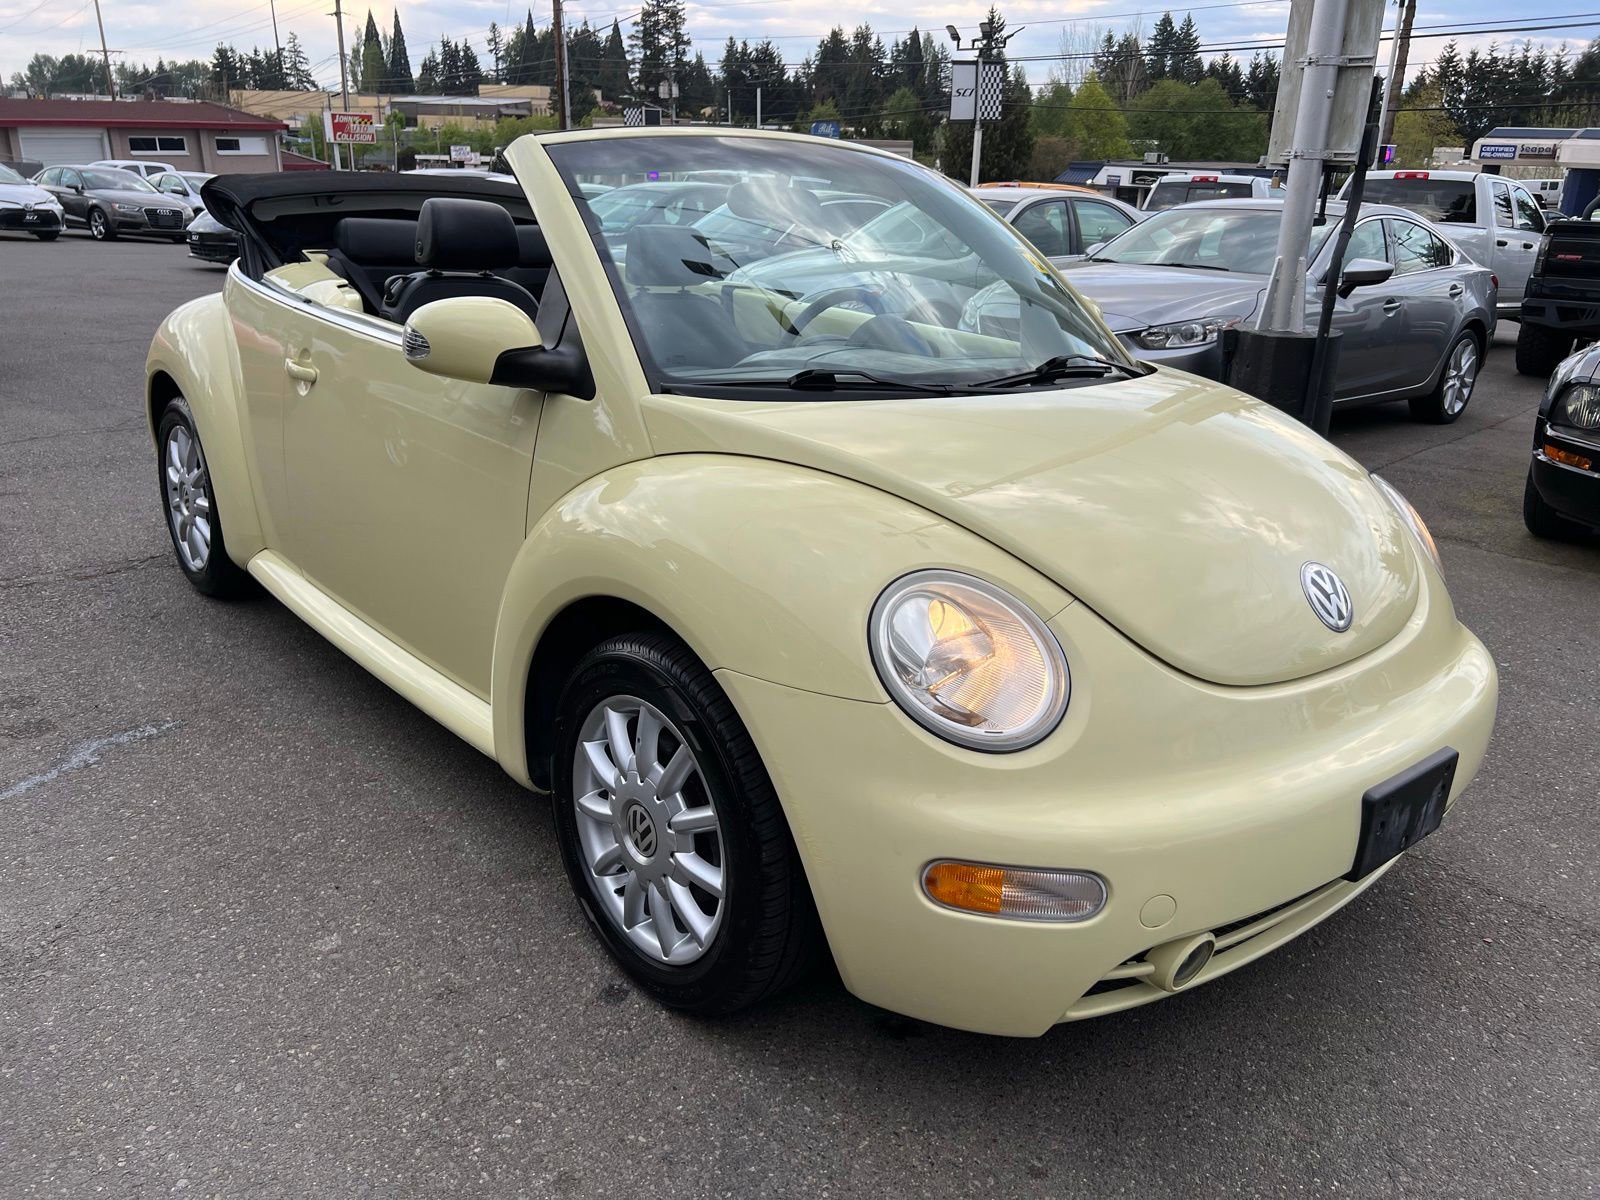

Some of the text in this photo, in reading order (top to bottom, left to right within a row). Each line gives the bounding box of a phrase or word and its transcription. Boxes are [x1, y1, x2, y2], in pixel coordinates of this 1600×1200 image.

[952, 88, 975, 97] SCI
[344, 123, 369, 133] AUTO
[335, 131, 373, 141] COLLISION
